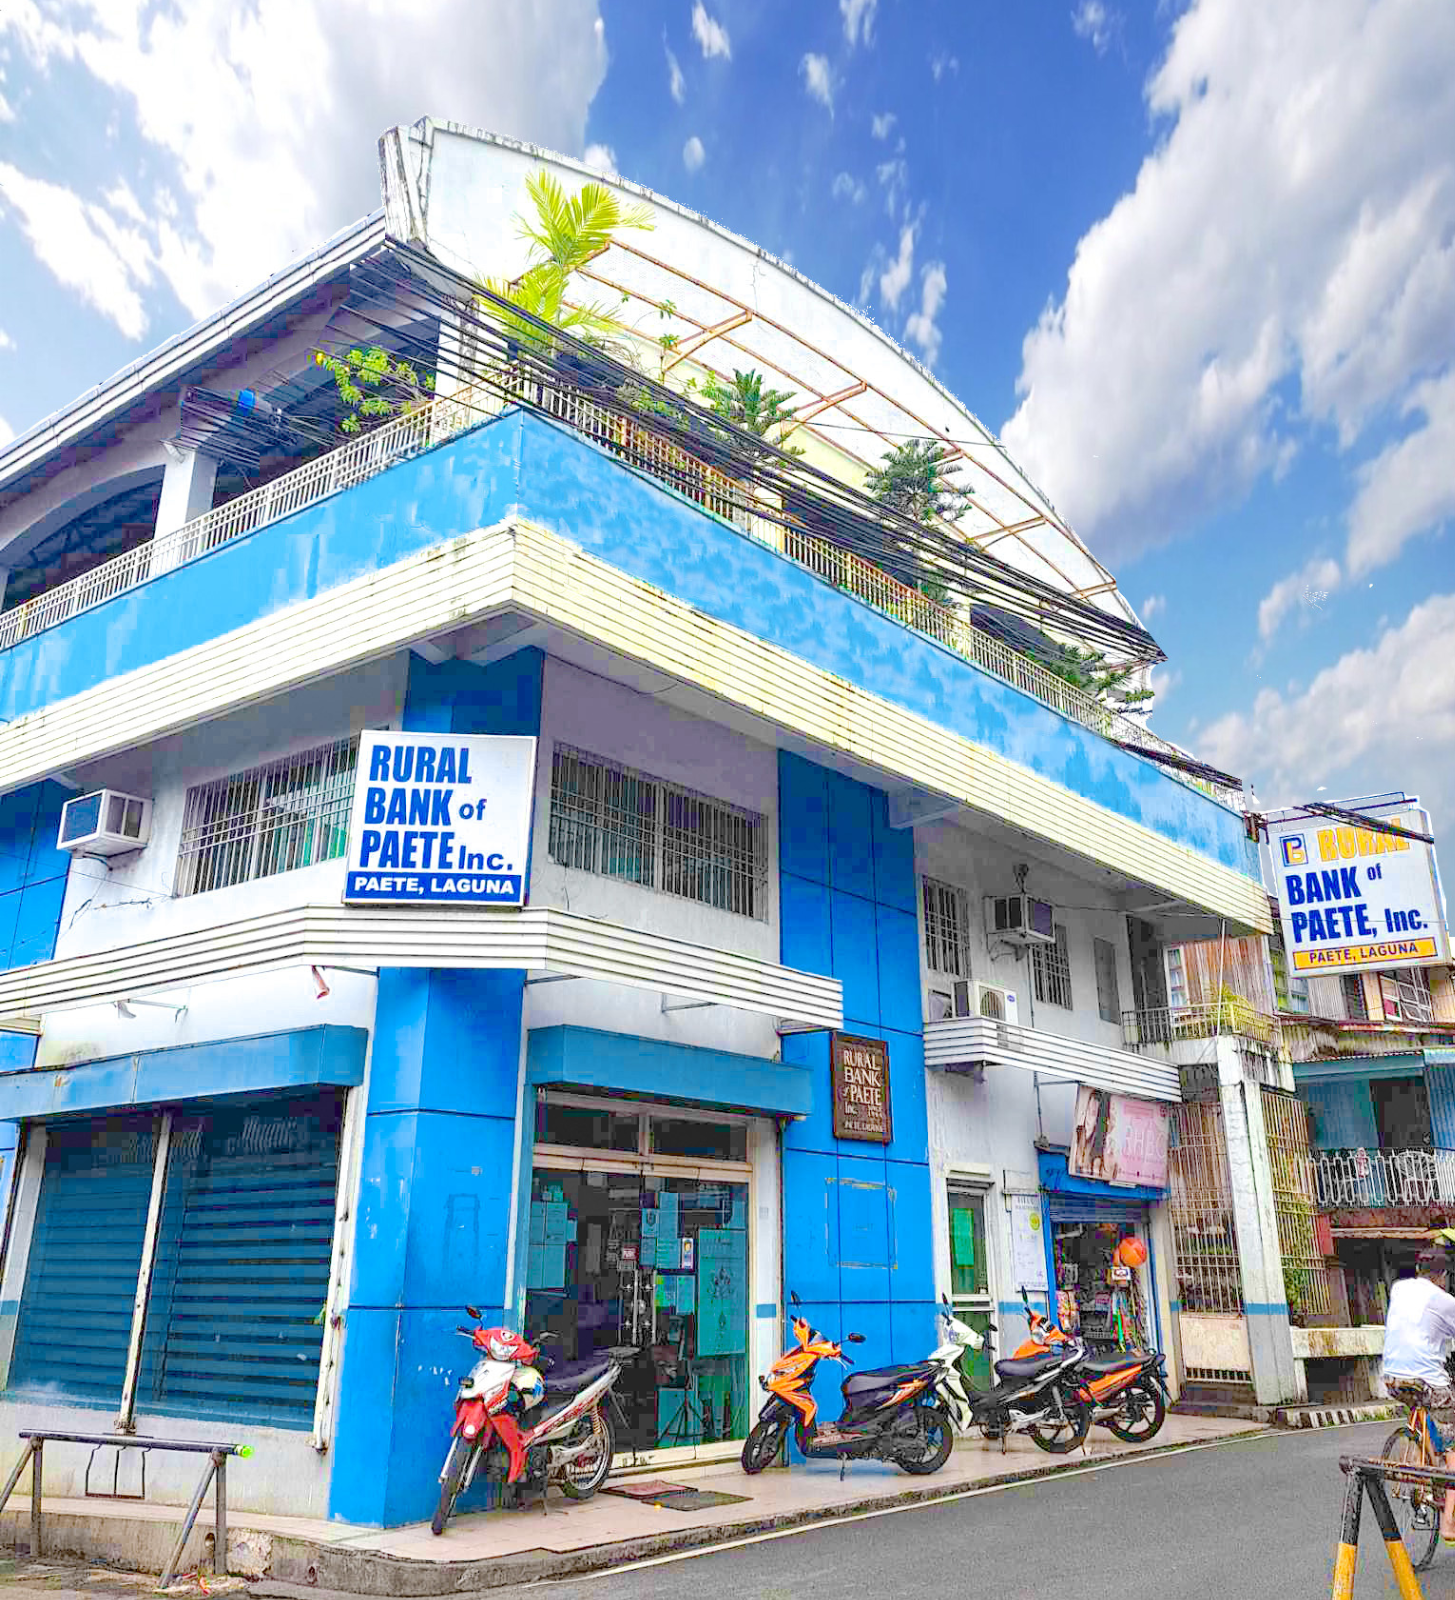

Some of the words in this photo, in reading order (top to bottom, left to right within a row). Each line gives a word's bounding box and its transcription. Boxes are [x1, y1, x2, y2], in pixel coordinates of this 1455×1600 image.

[369, 745, 472, 784] RURAL
[364, 787, 454, 826] BANK
[459, 798, 487, 820] of
[359, 830, 455, 870] PAETE
[458, 845, 513, 871] Inc.
[354, 877, 424, 895] PAETE,
[431, 878, 514, 895] LAGUNA
[1285, 866, 1362, 906] BANK
[1367, 863, 1382, 881] of
[1291, 903, 1378, 944] PAETE,
[1385, 908, 1428, 933] Inc.
[1309, 949, 1358, 964] PAETE,
[1360, 942, 1419, 959] LAGUNA
[843, 1049, 881, 1071] RURAL
[844, 1066, 881, 1087] BANK
[850, 1084, 882, 1106] PAETE
